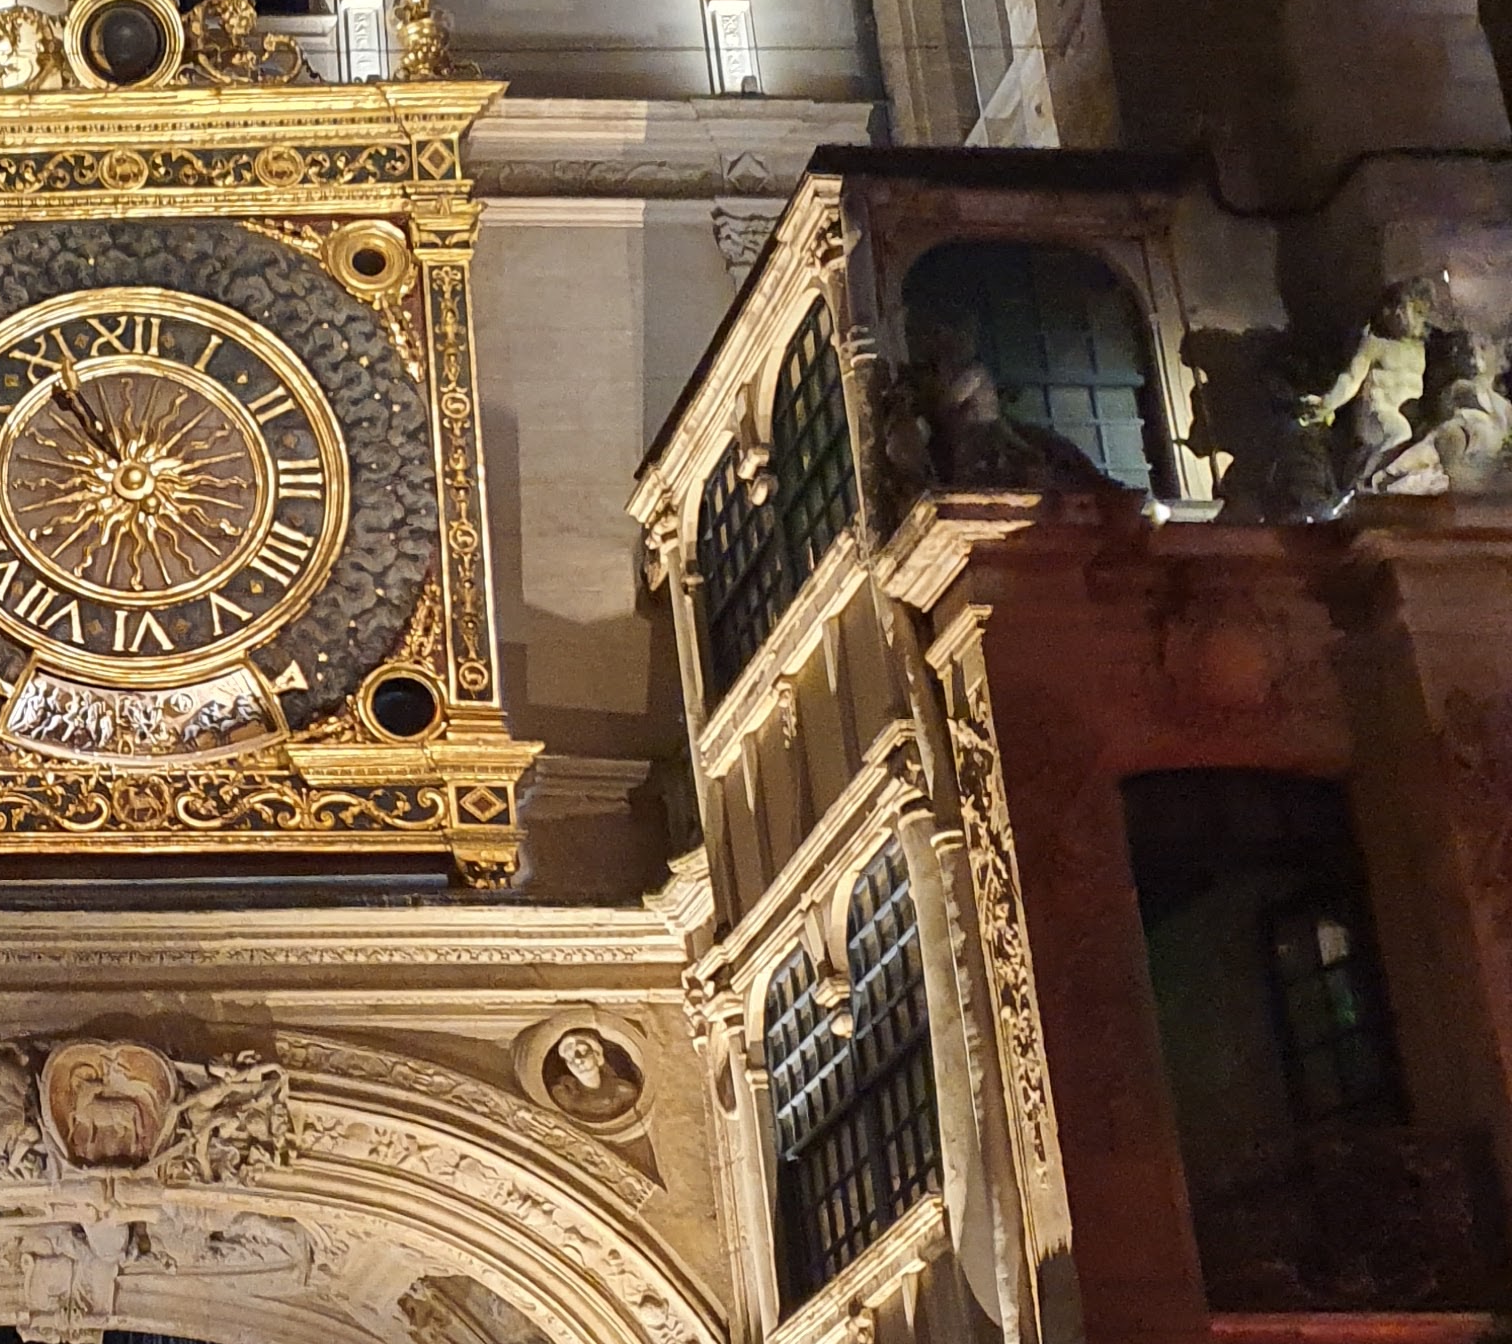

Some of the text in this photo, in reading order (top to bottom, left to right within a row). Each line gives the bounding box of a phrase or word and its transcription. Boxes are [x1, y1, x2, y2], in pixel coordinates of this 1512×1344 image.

[86, 316, 162, 357] XII
[246, 384, 296, 426] II
[276, 457, 325, 500] III
[13, 579, 86, 644] VII
[112, 610, 176, 652] VI
[208, 591, 254, 637] V
